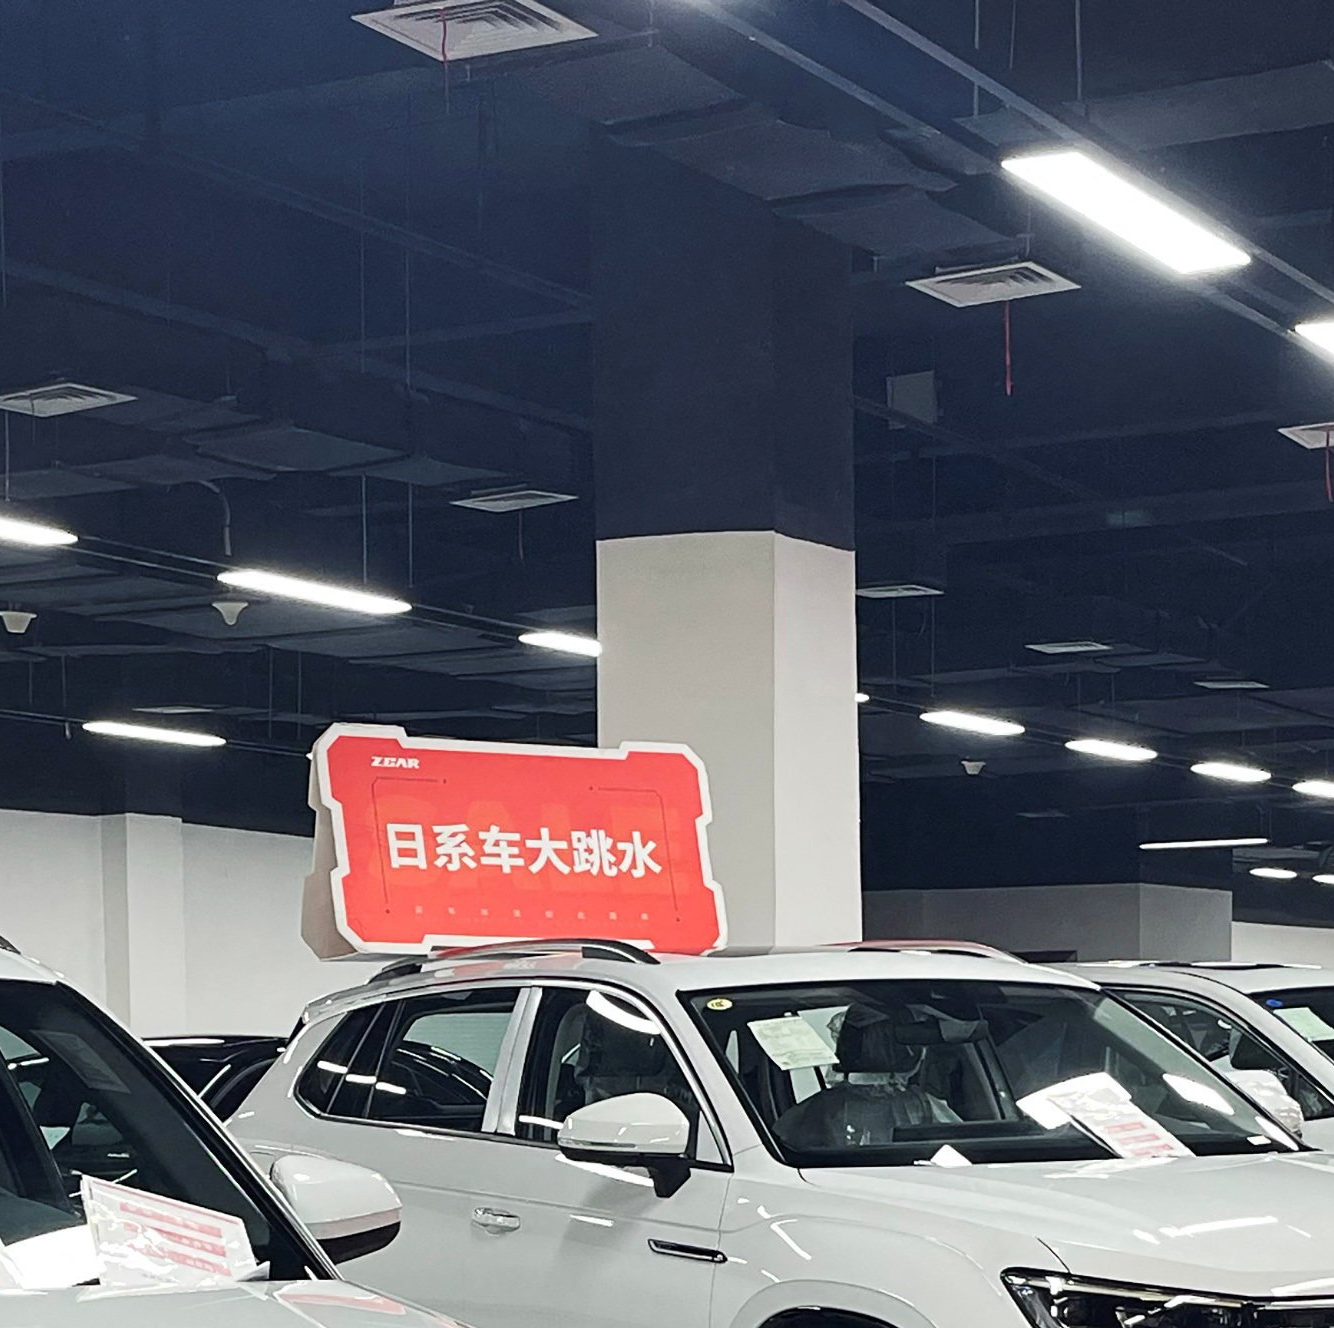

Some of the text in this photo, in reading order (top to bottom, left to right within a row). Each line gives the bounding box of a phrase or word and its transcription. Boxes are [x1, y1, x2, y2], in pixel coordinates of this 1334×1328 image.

[371, 756, 419, 769] ZCAR
[386, 823, 663, 879] 日系车大跳水
